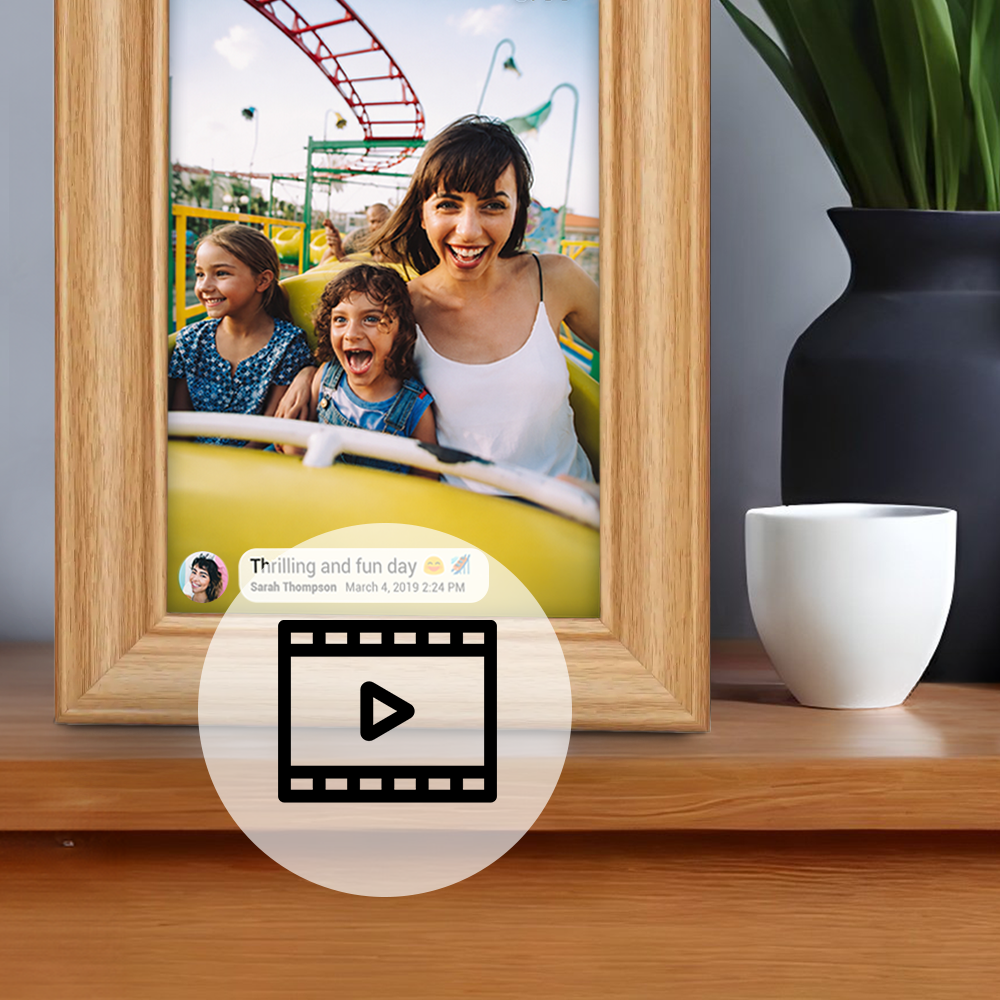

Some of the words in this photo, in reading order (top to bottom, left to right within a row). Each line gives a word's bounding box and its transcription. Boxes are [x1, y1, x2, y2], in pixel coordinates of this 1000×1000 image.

[250, 557, 316, 578] Thrilling
[321, 557, 351, 574] and
[355, 557, 383, 574] fun
[388, 557, 418, 579] day
[250, 581, 280, 593] Sarah
[283, 581, 338, 595] Thompson
[345, 581, 379, 593] March
[381, 582, 391, 595] 4,
[393, 581, 420, 593] 2019
[422, 581, 445, 593] 2:24
[447, 581, 466, 593] PM
